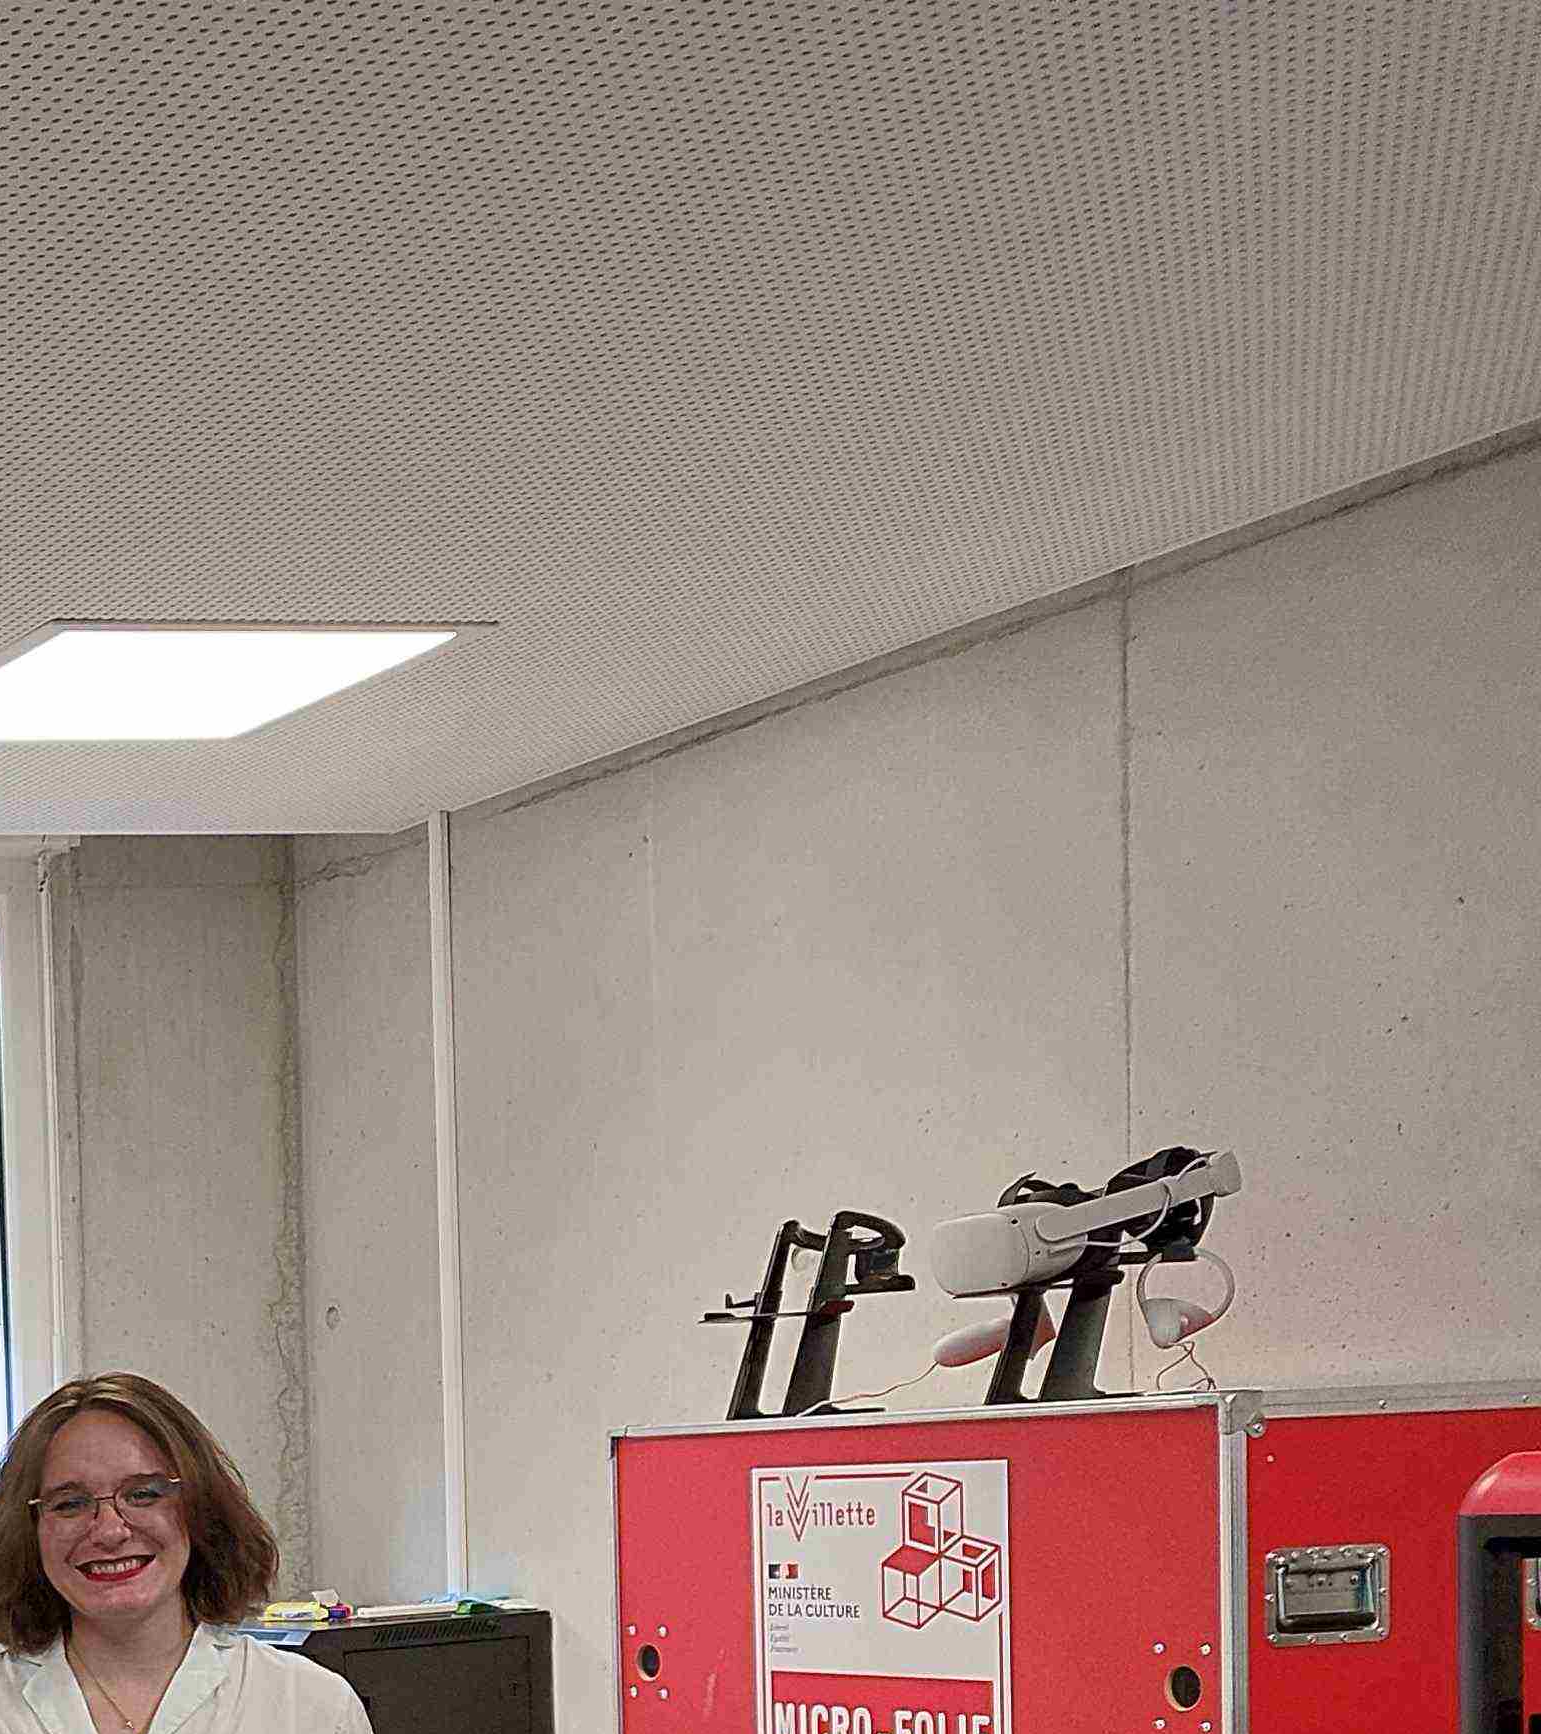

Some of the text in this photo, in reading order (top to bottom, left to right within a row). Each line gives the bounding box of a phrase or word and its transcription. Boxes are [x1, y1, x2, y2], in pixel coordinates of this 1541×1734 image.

[766, 1476, 877, 1542] la Villette
[768, 1584, 832, 1601] MINISTÈRE
[768, 1604, 861, 1619] DE LA CULTURE
